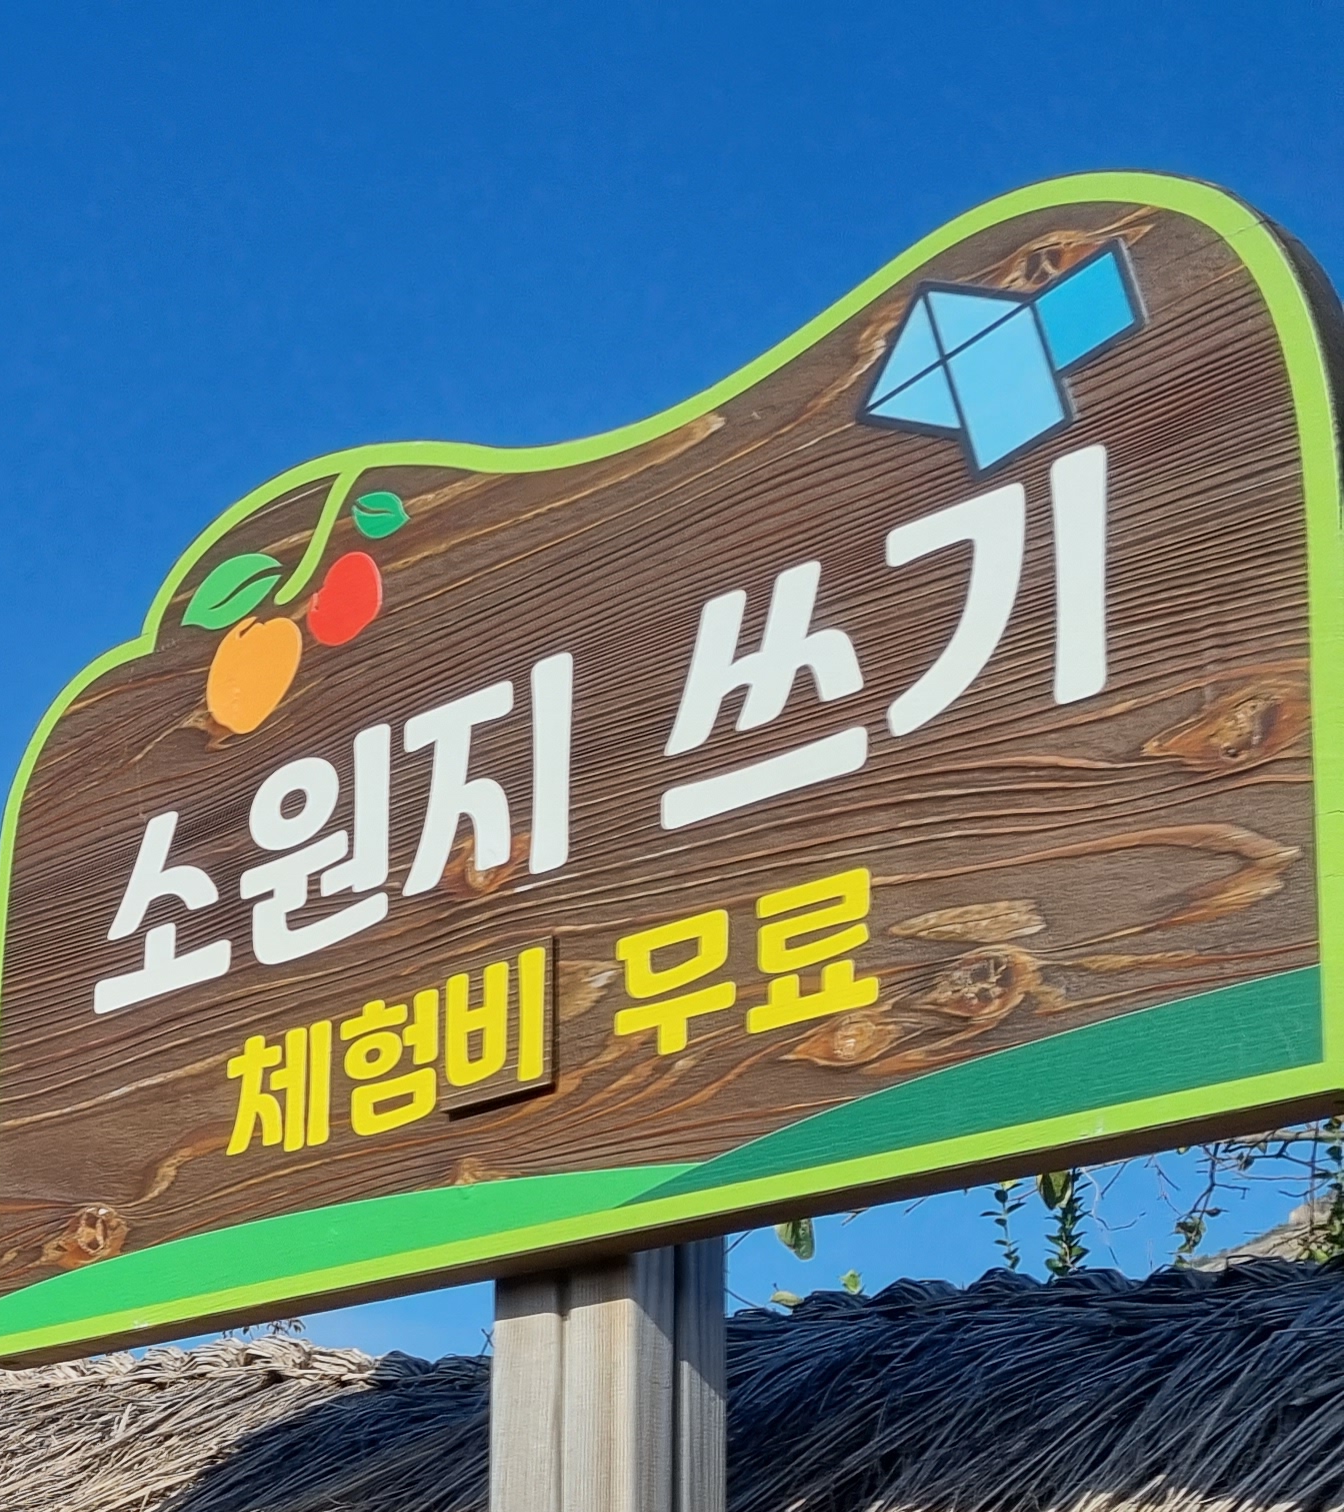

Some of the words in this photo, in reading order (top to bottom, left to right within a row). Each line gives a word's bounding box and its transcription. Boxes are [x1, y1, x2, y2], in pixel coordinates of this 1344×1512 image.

[94, 651, 572, 1014] 소원지
[661, 444, 1108, 830] 쓰기
[226, 946, 546, 1156] 체험비
[614, 868, 880, 1055] 무료
